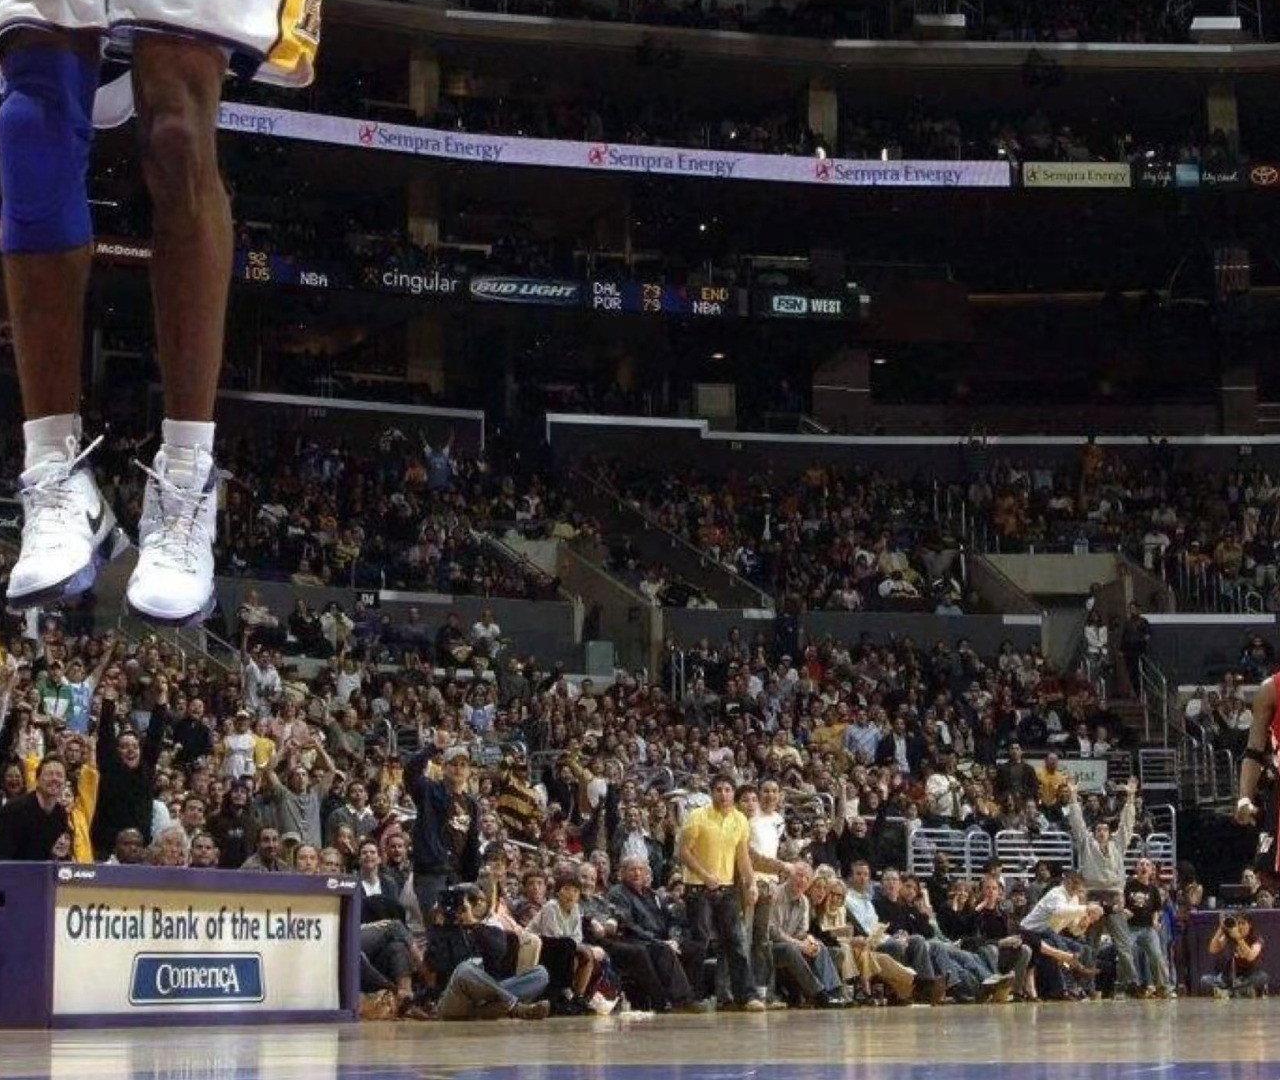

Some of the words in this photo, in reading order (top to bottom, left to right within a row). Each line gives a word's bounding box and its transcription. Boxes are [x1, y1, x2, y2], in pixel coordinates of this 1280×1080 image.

[379, 128, 441, 155] Sempra
[445, 135, 502, 160] Energy
[608, 147, 674, 173] Sempra
[679, 153, 734, 176] Energy
[834, 164, 900, 186] Sempra
[905, 165, 962, 186] Energy
[382, 269, 457, 294] cingular
[474, 280, 517, 294] BUD
[520, 284, 578, 298] LIGHT
[592, 282, 621, 296] DAL
[66, 903, 145, 940] Official
[152, 906, 198, 940] Bank
[206, 905, 226, 940] of
[231, 906, 260, 940] the
[266, 907, 322, 941] Lakers
